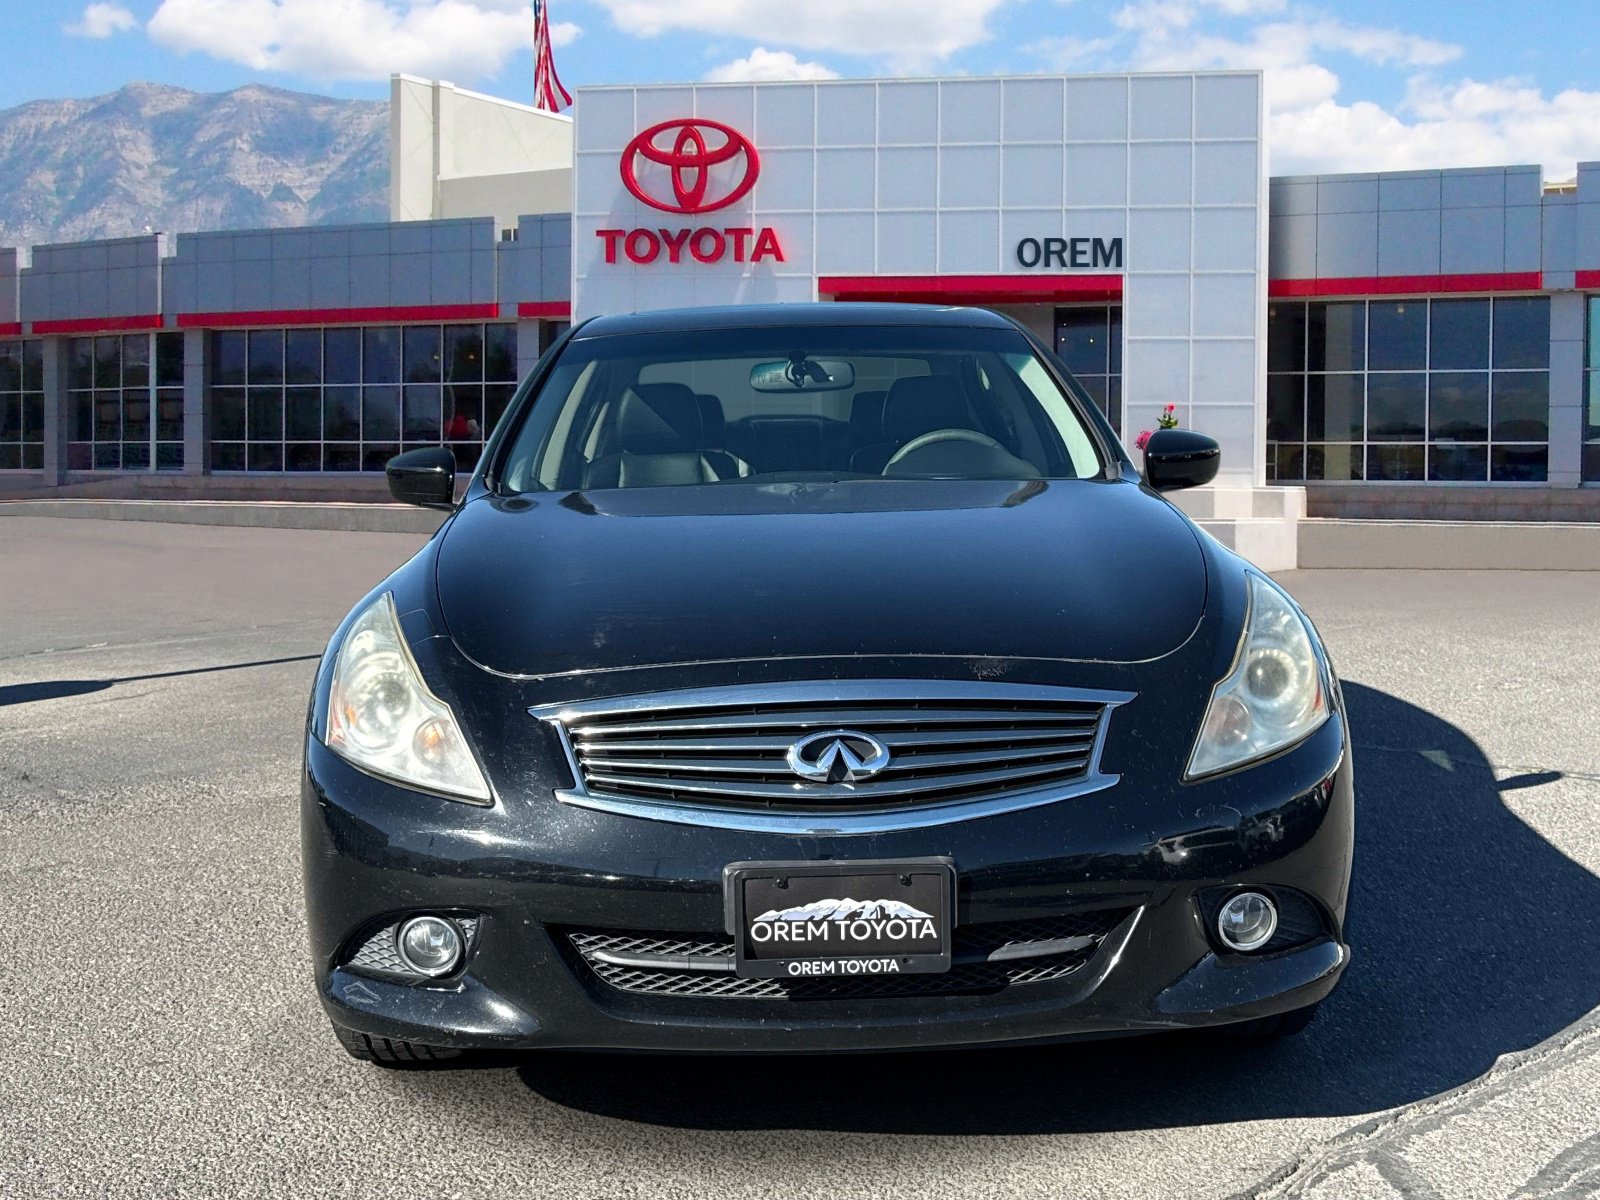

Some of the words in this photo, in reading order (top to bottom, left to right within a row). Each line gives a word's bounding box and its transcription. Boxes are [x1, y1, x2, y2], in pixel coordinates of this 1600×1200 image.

[596, 227, 785, 264] TOYOTA
[1016, 237, 1123, 268] OREM
[751, 921, 828, 942] OREM
[835, 919, 937, 940] TOYOTA
[788, 962, 835, 975] OREM
[838, 959, 899, 974] TOYOTA
